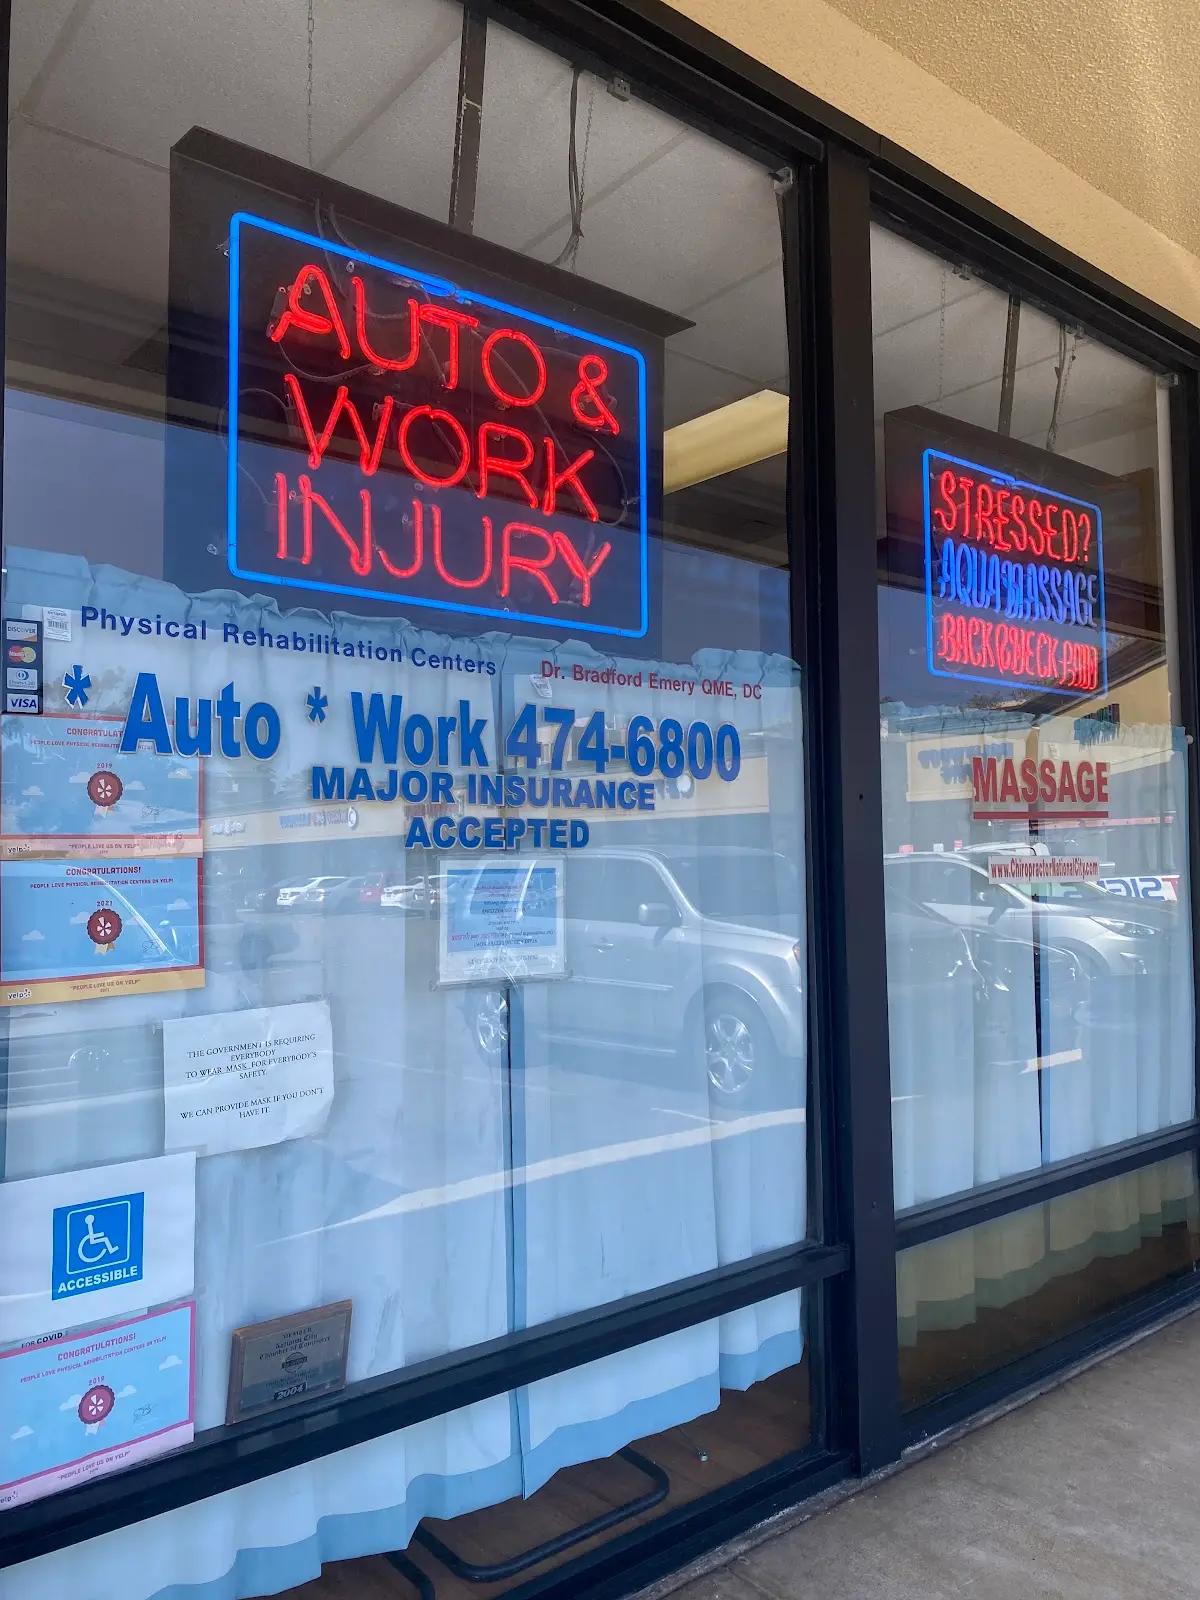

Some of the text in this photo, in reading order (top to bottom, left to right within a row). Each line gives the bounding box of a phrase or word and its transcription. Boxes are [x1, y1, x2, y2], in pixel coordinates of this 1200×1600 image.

[271, 264, 619, 435] AUTO &
[284, 374, 598, 521] WORK
[934, 470, 1091, 562] STRESSED?
[275, 472, 612, 607] INJURY
[937, 537, 1001, 613] AQUA
[81, 605, 207, 640] Physical
[223, 622, 402, 663] Rehabilitation
[411, 648, 497, 676] Centers
[938, 612, 996, 668] BACK
[541, 660, 565, 679] Dr.
[573, 663, 642, 687] Bradford
[649, 672, 695, 695] Emery
[701, 679, 737, 700] QME,
[743, 684, 762, 699] DC
[11, 699, 37, 708] VISA
[66, 727, 124, 738] CONGRATULAT
[118, 672, 742, 782] Auto Work 474-6800
[311, 765, 455, 803] MAJOR
[467, 773, 655, 812] INSURANCE
[972, 756, 1110, 803] MASSAGE
[404, 815, 591, 850] ACCEPTED
[66, 867, 141, 876] CONGRATULATIONS!
[991, 858, 1098, 881] www.ChiropractorNationalCity.com
[187, 1050, 205, 1059] THE
[206, 1042, 262, 1056] GOVERNMENT
[274, 1034, 316, 1046] REQUIRING
[231, 1049, 276, 1062] EVERYBODY
[185, 1052, 317, 1079] TO WEAR MASK FOR EVERYBODY'S
[240, 1069, 268, 1080] SAFETY.
[181, 1111, 194, 1120] WE
[196, 1108, 213, 1117] CAN
[215, 1101, 249, 1113] PROVIDE
[251, 1096, 272, 1107] MASK
[282, 1092, 298, 1101] YOU
[300, 1087, 324, 1098] DON'T
[240, 1109, 260, 1119] HAVE
[58, 1265, 138, 1293] ACCESSIBLE
[37, 1332, 64, 1344] COVID
[57, 1333, 136, 1361] CONGRATULATIONS!
[20, 1373, 41, 1383] PEOPLE
[42, 1369, 57, 1378] LOVE
[57, 1363, 83, 1373] PHYSICAL
[88, 1376, 105, 1386] 2019
[277, 1384, 304, 1401] 2004
[83, 1463, 96, 1472] LOVE
